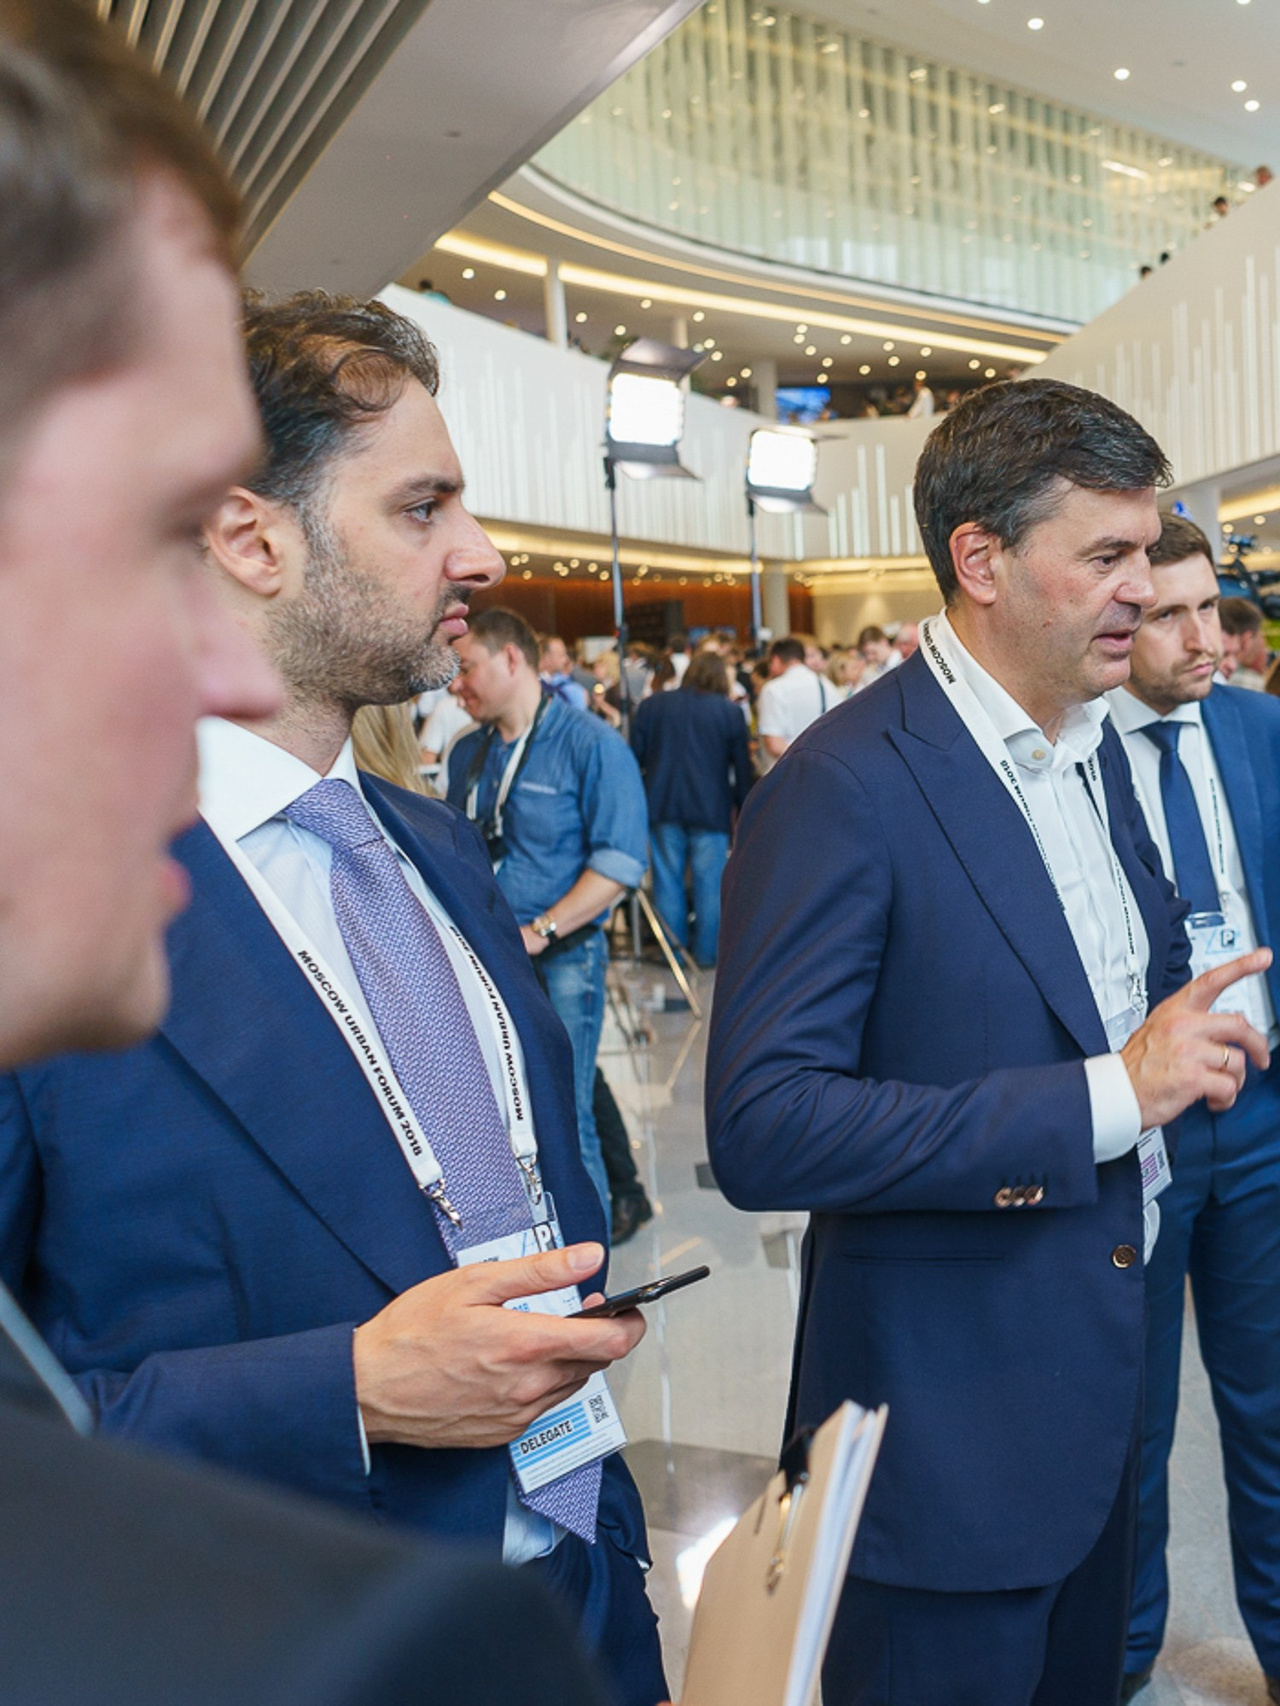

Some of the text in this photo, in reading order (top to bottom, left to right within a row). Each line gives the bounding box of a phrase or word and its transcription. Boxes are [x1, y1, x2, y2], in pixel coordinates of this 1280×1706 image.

[929, 644, 956, 684] MOSCOW
[492, 1001, 511, 1050] URBAN
[298, 950, 423, 1157] MOSCOW URBAN FORUM 2018
[505, 1052, 524, 1121] MOSCOW
[520, 1420, 573, 1455] DELEGATE
